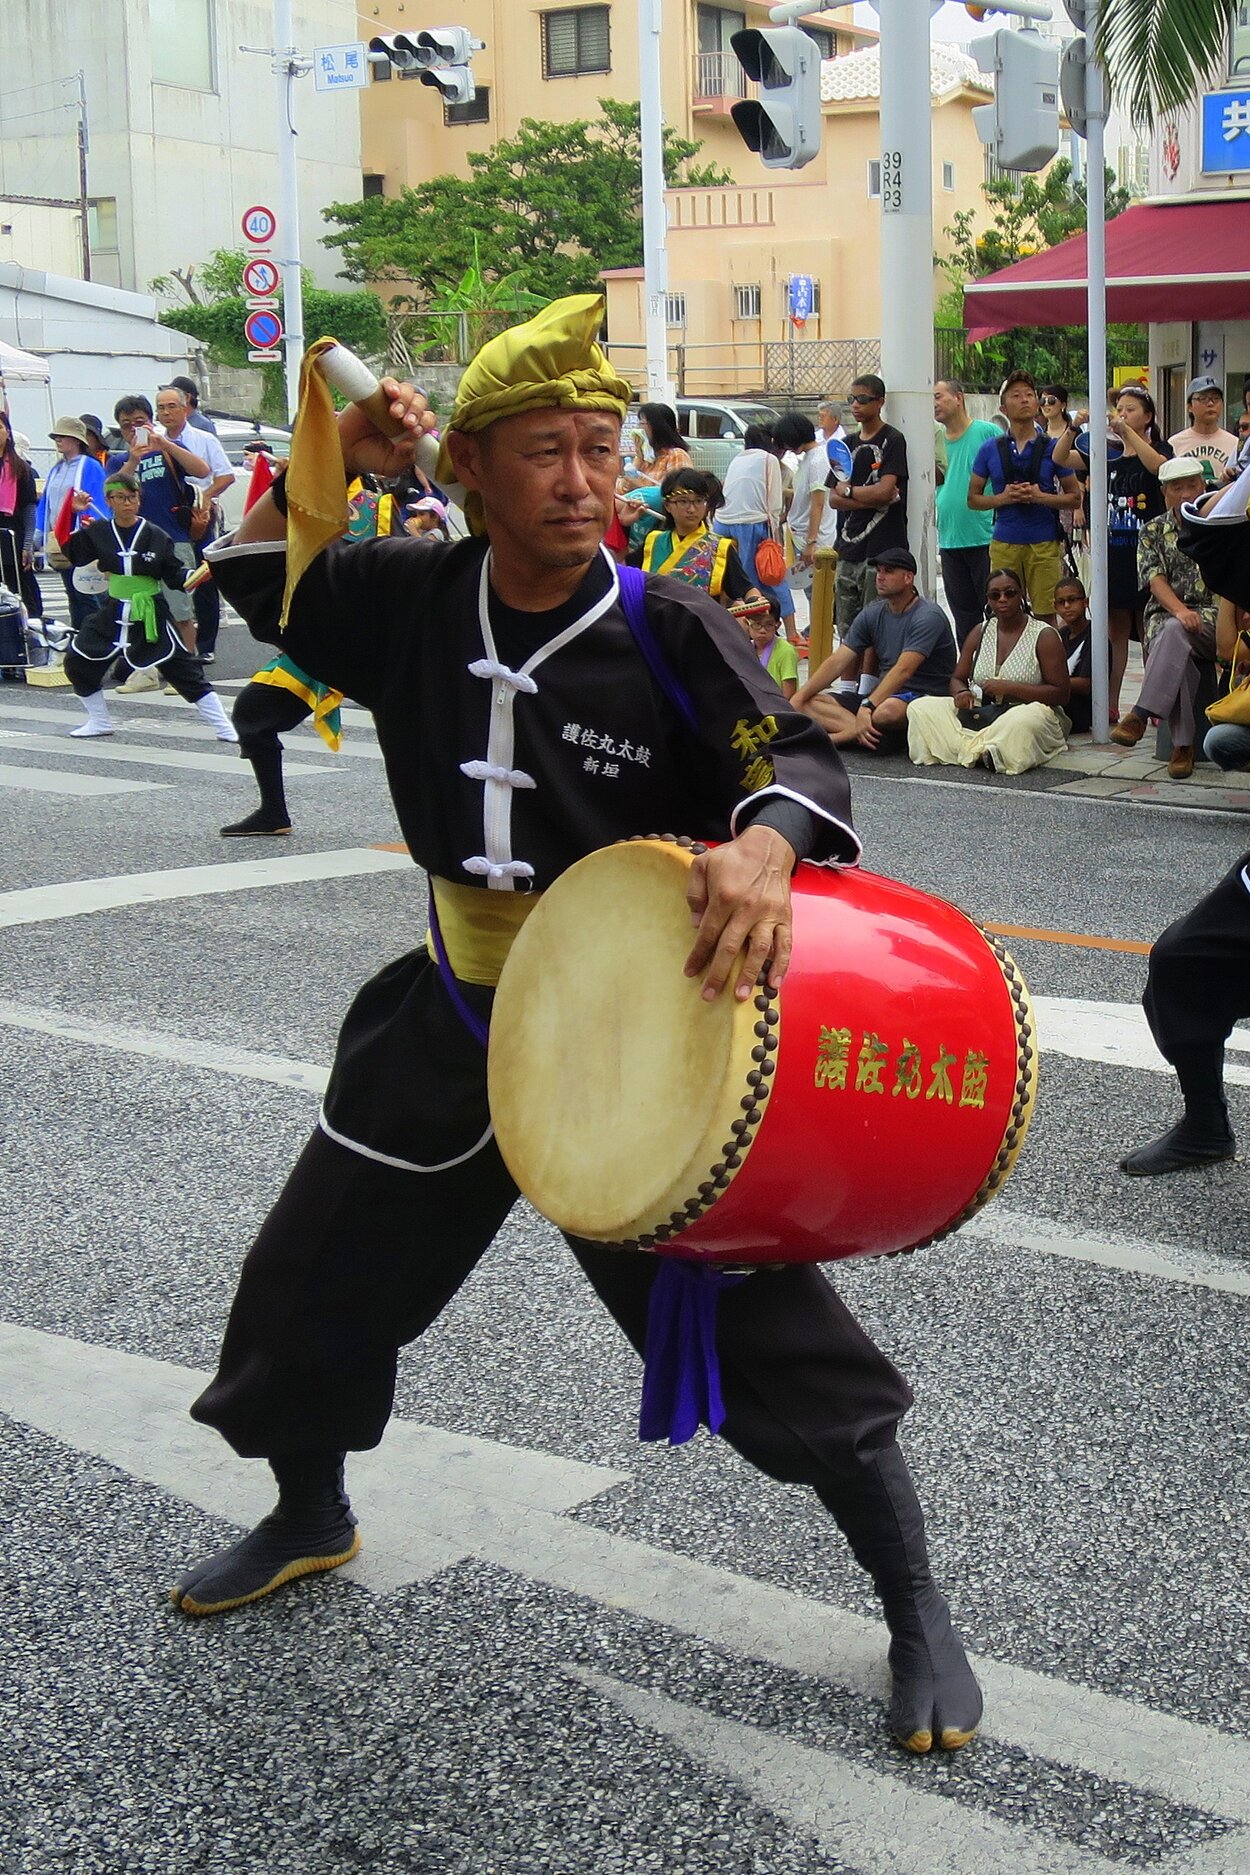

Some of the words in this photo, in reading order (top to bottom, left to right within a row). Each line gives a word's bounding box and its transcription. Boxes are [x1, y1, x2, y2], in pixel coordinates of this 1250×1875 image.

[320, 50, 359, 72] 松尾
[327, 73, 354, 85] Matsuo
[883, 151, 902, 169] 39
[883, 171, 902, 189] R4
[883, 190, 902, 208] P3
[250, 216, 268, 233] 40
[561, 722, 653, 769] 護佐丸太鼓
[582, 755, 620, 779] 新垣
